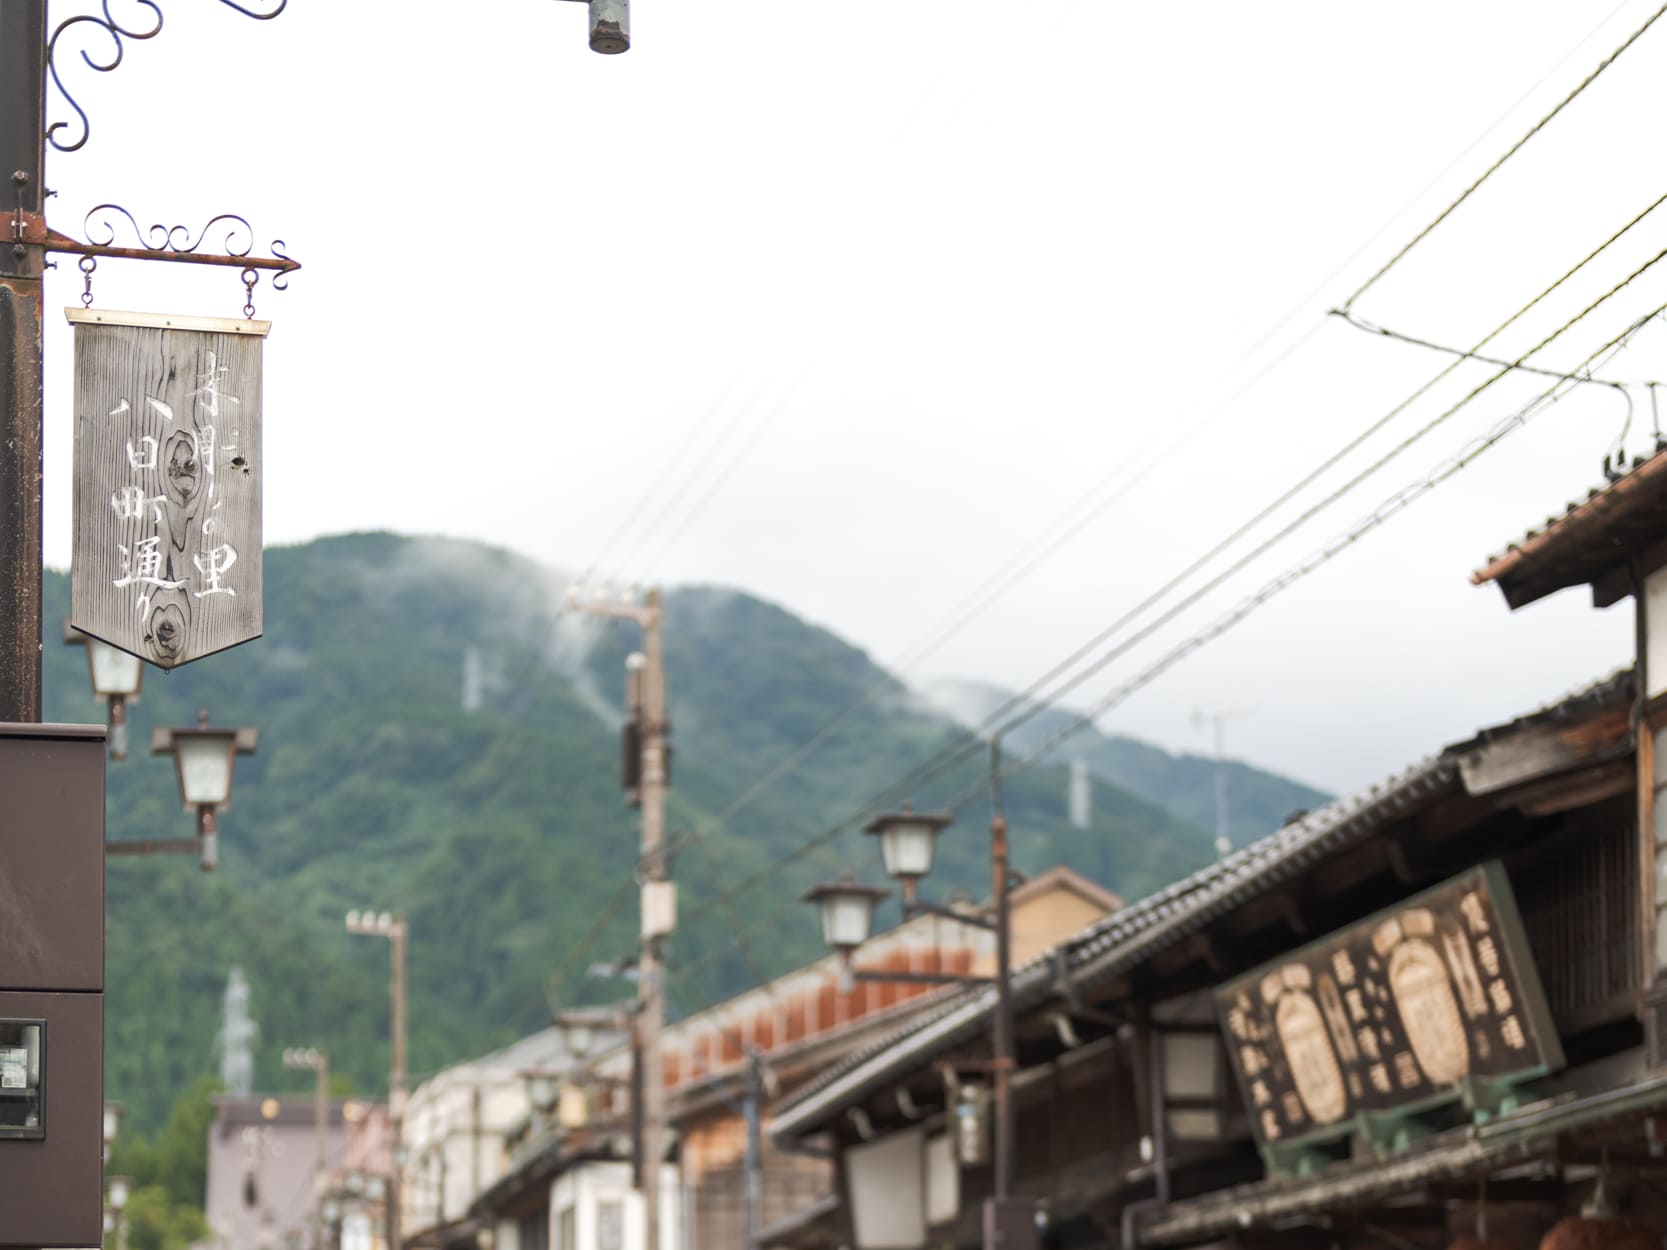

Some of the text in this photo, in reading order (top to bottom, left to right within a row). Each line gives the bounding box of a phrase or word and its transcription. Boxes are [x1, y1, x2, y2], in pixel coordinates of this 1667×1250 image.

[106, 395, 189, 623] 八日町通り
